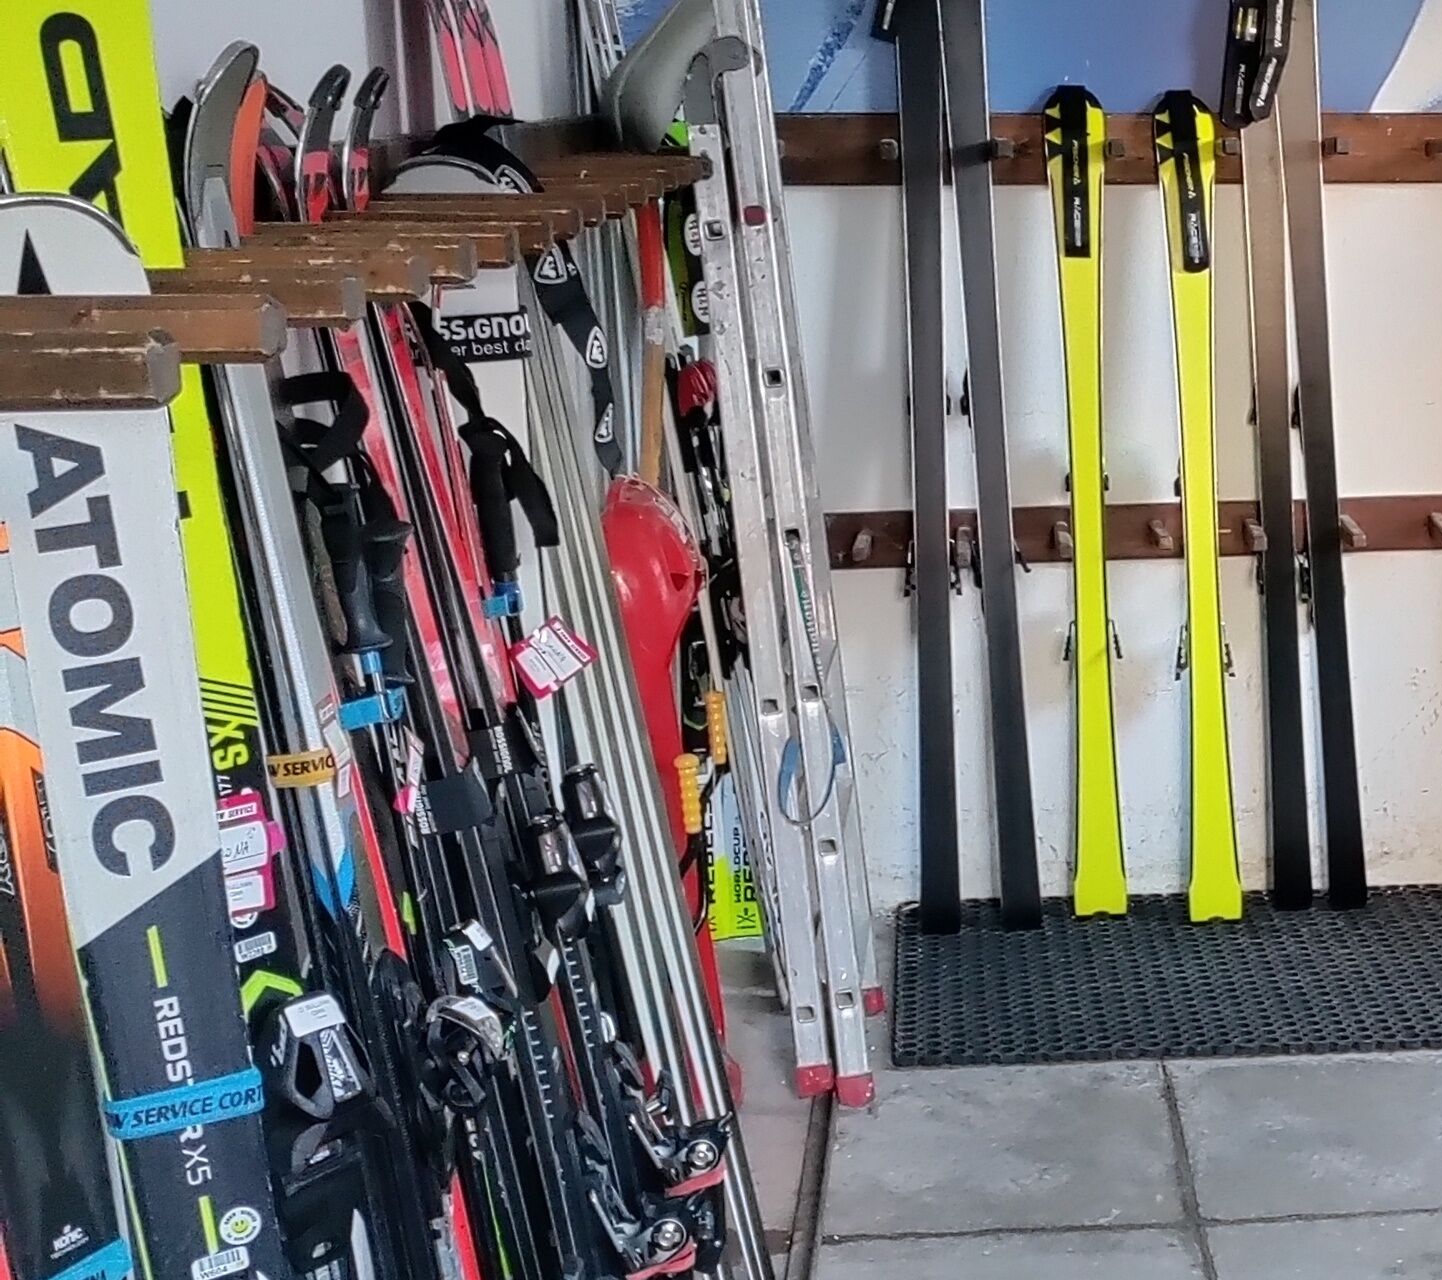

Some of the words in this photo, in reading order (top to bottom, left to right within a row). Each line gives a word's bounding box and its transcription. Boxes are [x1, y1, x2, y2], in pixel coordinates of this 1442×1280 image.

[472, 340, 510, 356] best
[14, 422, 177, 878] ATOMIC
[282, 754, 336, 778] SERVIC
[130, 1096, 213, 1129] SERVICE
[218, 1084, 262, 1110] CORT
[153, 996, 204, 1143] REDSR
[181, 1144, 213, 1186] X5
